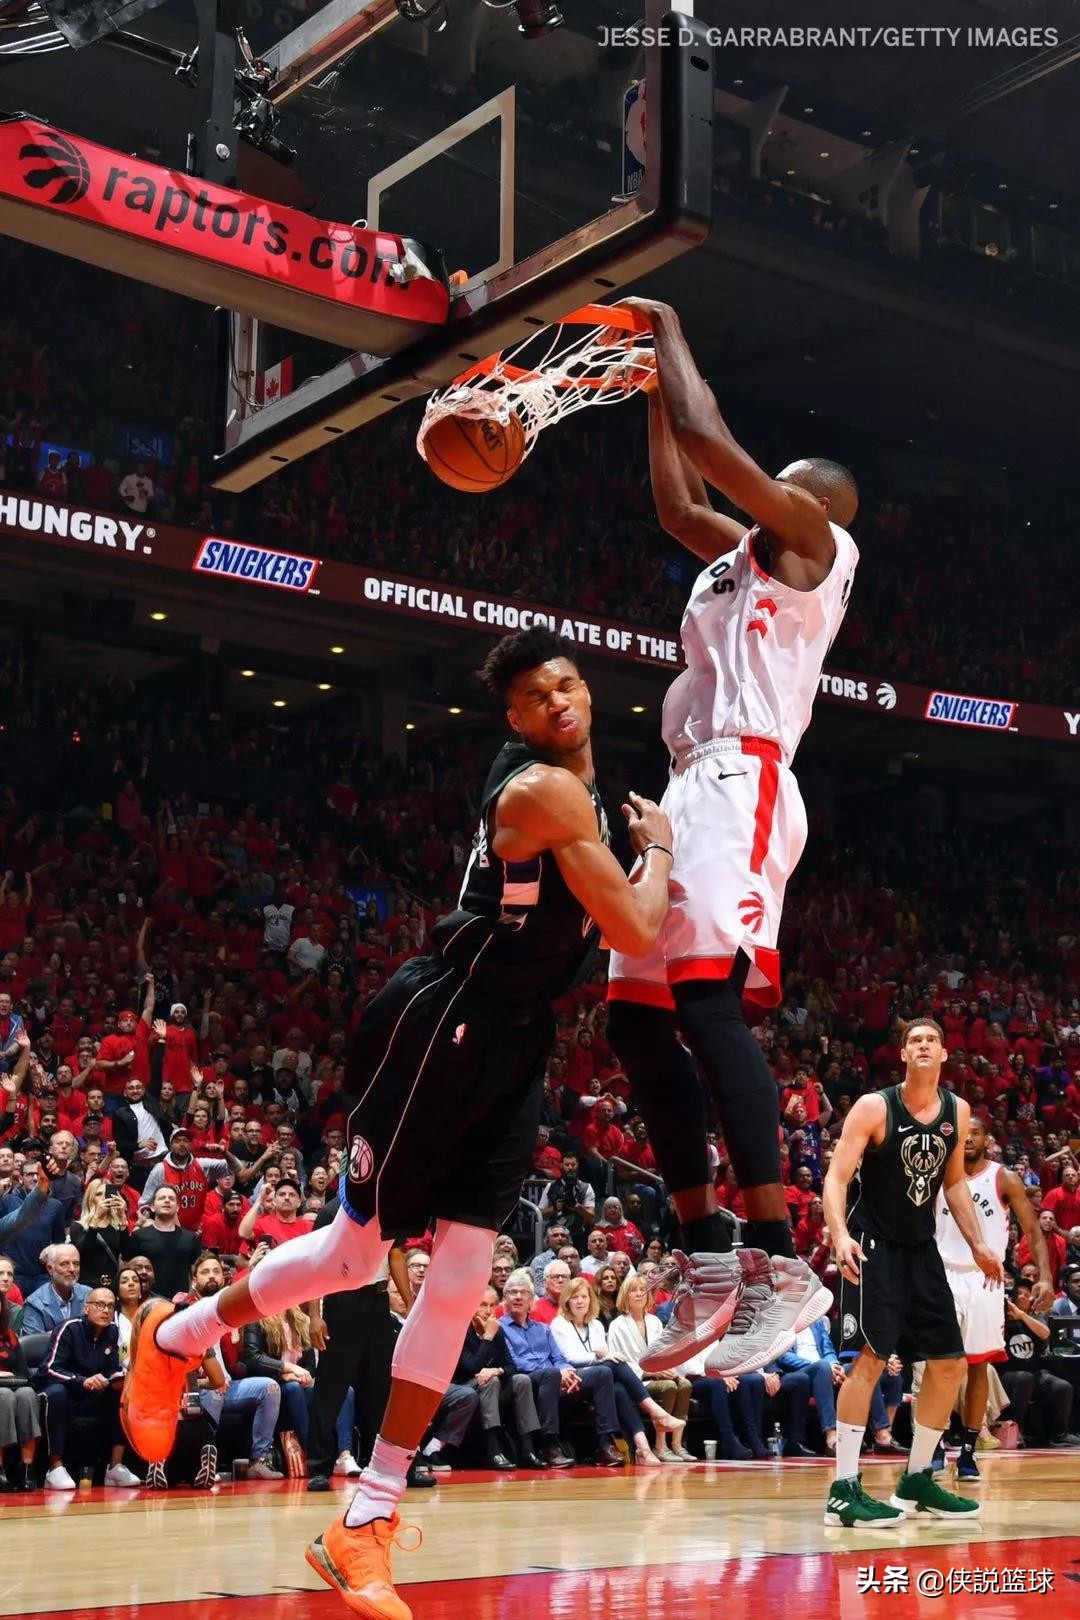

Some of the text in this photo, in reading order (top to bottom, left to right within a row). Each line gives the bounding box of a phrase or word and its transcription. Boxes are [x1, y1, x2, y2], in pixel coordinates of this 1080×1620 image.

[200, 540, 314, 589] SNICKERS
[364, 577, 468, 619] OFFICIAL
[606, 628, 633, 652] OF
[636, 633, 678, 662] THE
[929, 694, 1012, 728] SNICKERS
[921, 1133, 930, 1151] 11
[181, 1195, 196, 1209] 33
[1010, 1341, 1032, 1354] TNT
